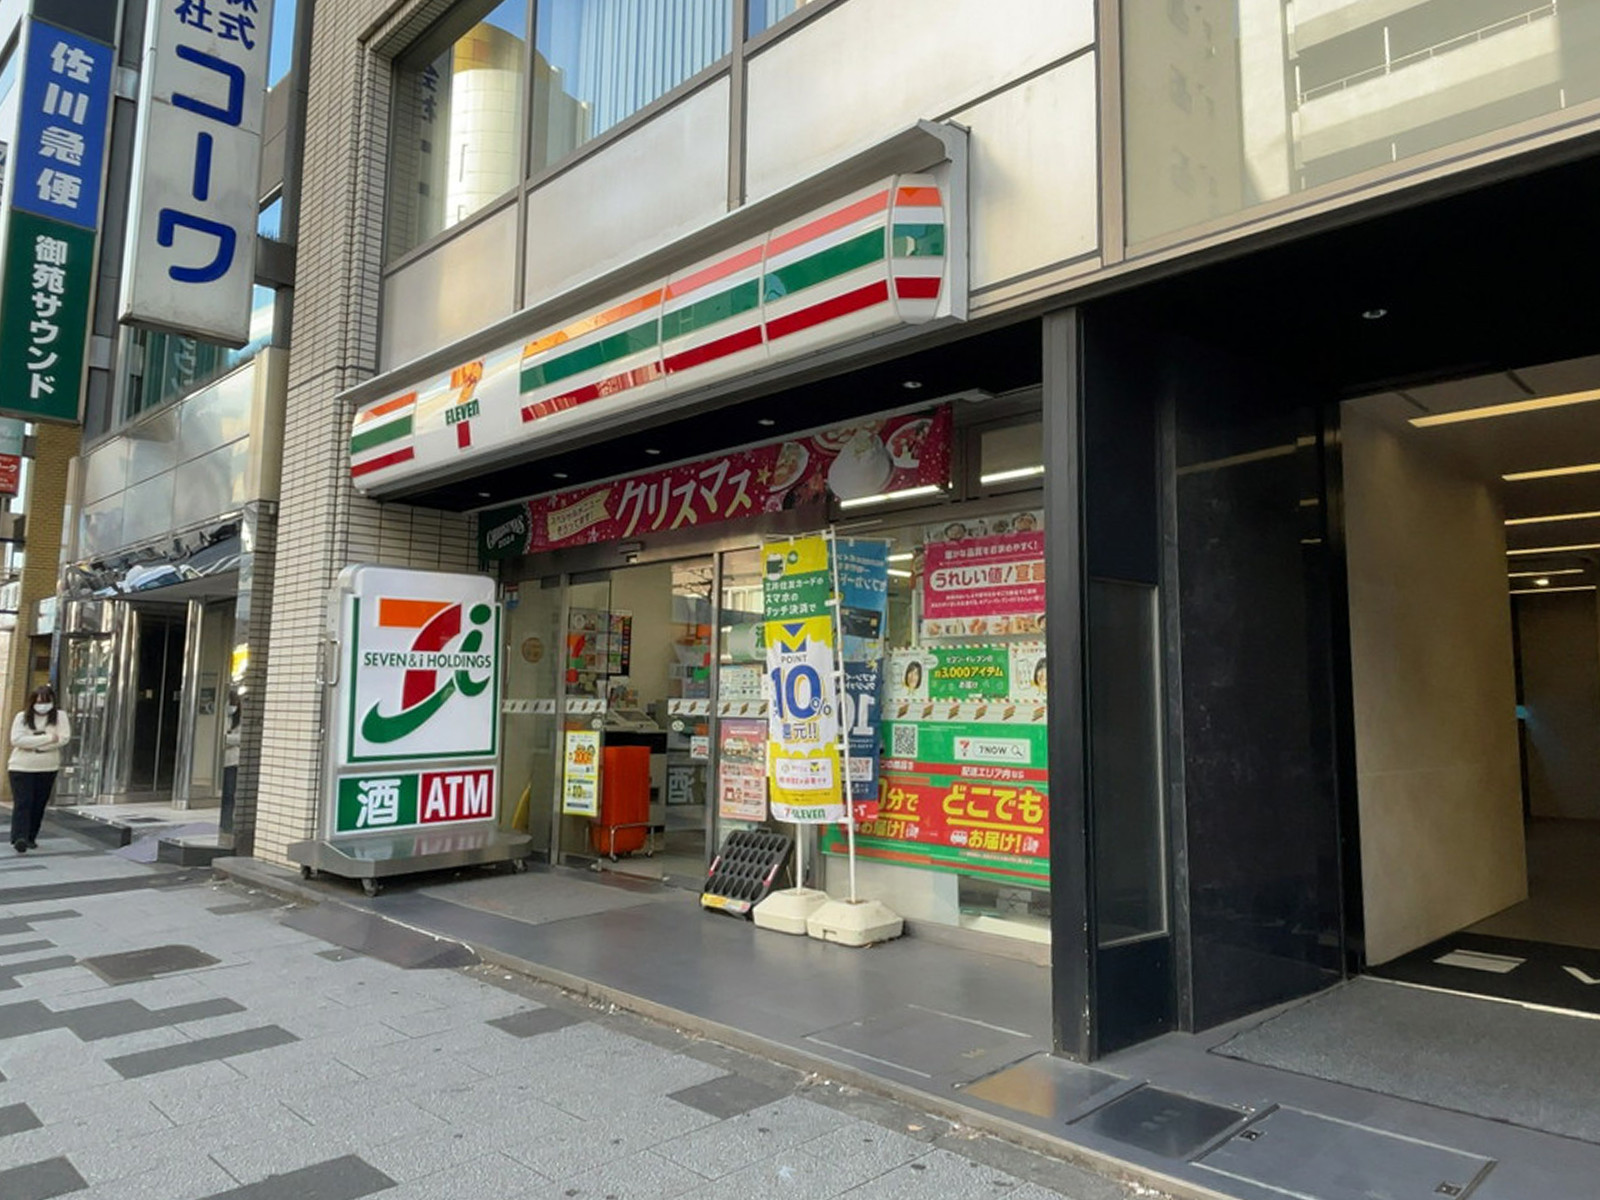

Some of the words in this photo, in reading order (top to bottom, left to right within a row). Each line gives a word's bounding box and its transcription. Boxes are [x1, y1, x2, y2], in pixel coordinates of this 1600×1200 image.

[36, 41, 95, 209] 佐川急便
[157, 44, 246, 284] コーワ
[27, 235, 68, 399] 御苑サウンド
[615, 459, 753, 538] クリスマス
[427, 653, 492, 669] HOLDINGS
[781, 654, 808, 664] POINT
[770, 665, 832, 719] 10%
[979, 744, 1008, 755] 7NOW
[356, 779, 402, 828] 酒
[424, 773, 490, 820] ATM
[942, 784, 1044, 824] どこでも
[968, 830, 1022, 853] お届け!
